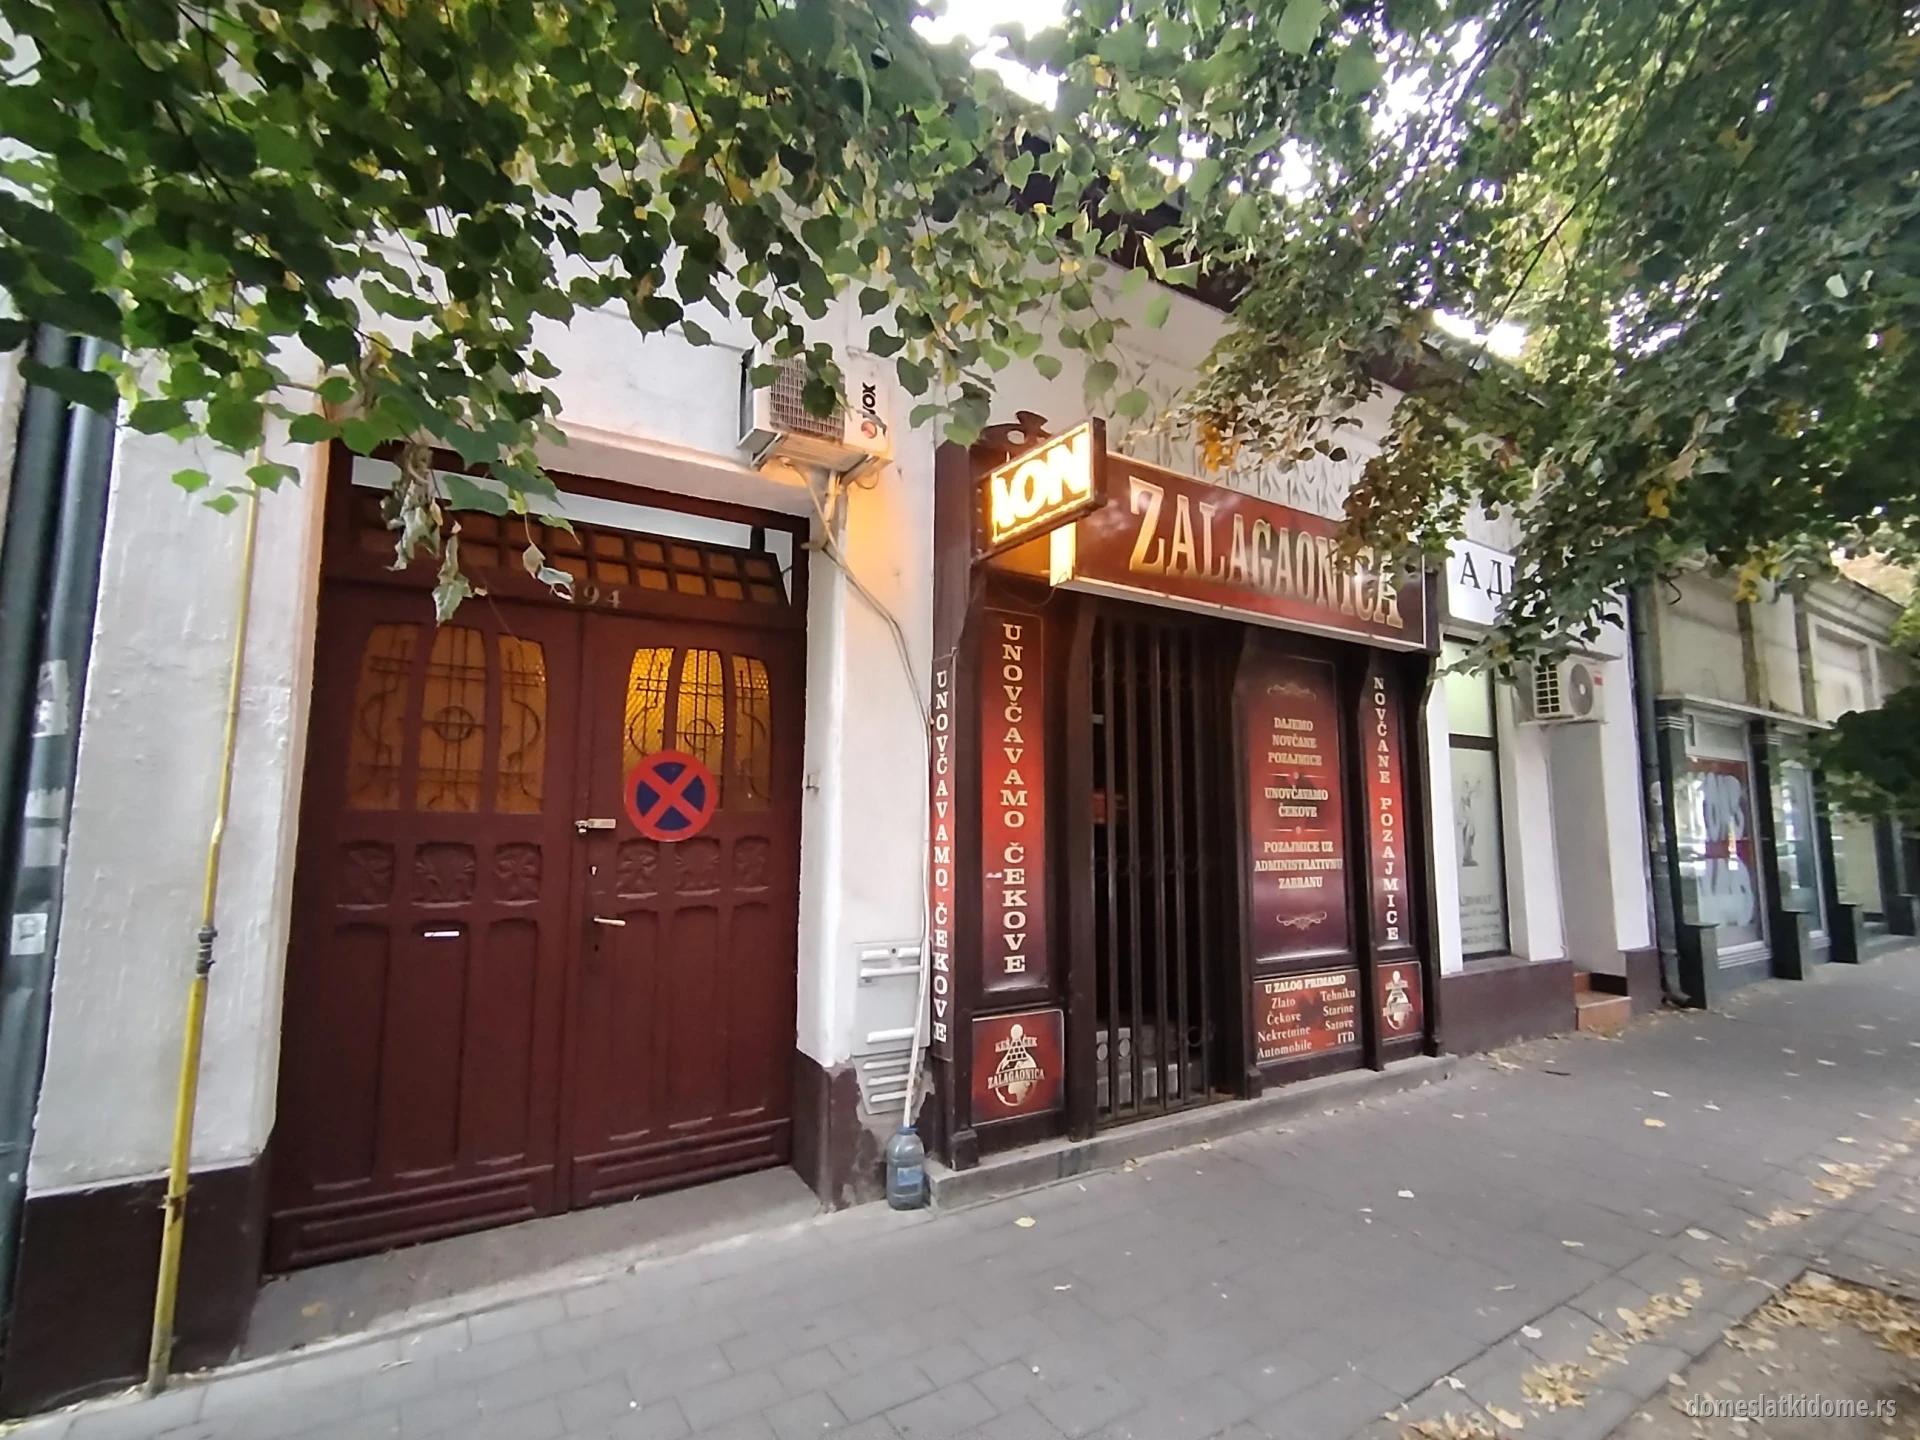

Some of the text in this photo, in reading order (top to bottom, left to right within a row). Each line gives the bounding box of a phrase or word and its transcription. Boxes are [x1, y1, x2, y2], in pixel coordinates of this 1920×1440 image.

[1128, 475, 1404, 629] ZALAGAONICA
[1273, 717, 1314, 731] DAJEMO
[1272, 734, 1317, 748] NOVČANE
[1268, 752, 1322, 766] POZAJMICE
[1000, 623, 1028, 974] UNOVČAVAMO ČEKOVE
[1264, 785, 1329, 801] UNOVČAVAMO
[1278, 802, 1318, 818] ČEKOVE
[1374, 677, 1399, 941] NOVČANE POZAJMICE
[1263, 841, 1334, 853] POZAJMICE UZ
[933, 671, 950, 1043] UNOVČAVAMO ČEKOVE
[1254, 859, 1343, 872] ADMINISTRATIVNU
[1278, 876, 1323, 889] ZABRANU
[1264, 974, 1346, 994] U ZALOG PRIMAMO
[1320, 988, 1356, 1002] Tehniku
[1271, 997, 1296, 1009] Zlato
[1323, 1004, 1354, 1017] Starine
[1266, 1011, 1302, 1026] Čekove
[1325, 1019, 1354, 1031] Satove
[1257, 1024, 1311, 1043] Nekretnine
[1257, 1039, 1312, 1059] Automobile
[987, 1068, 1045, 1090] ZALAGAONICA
